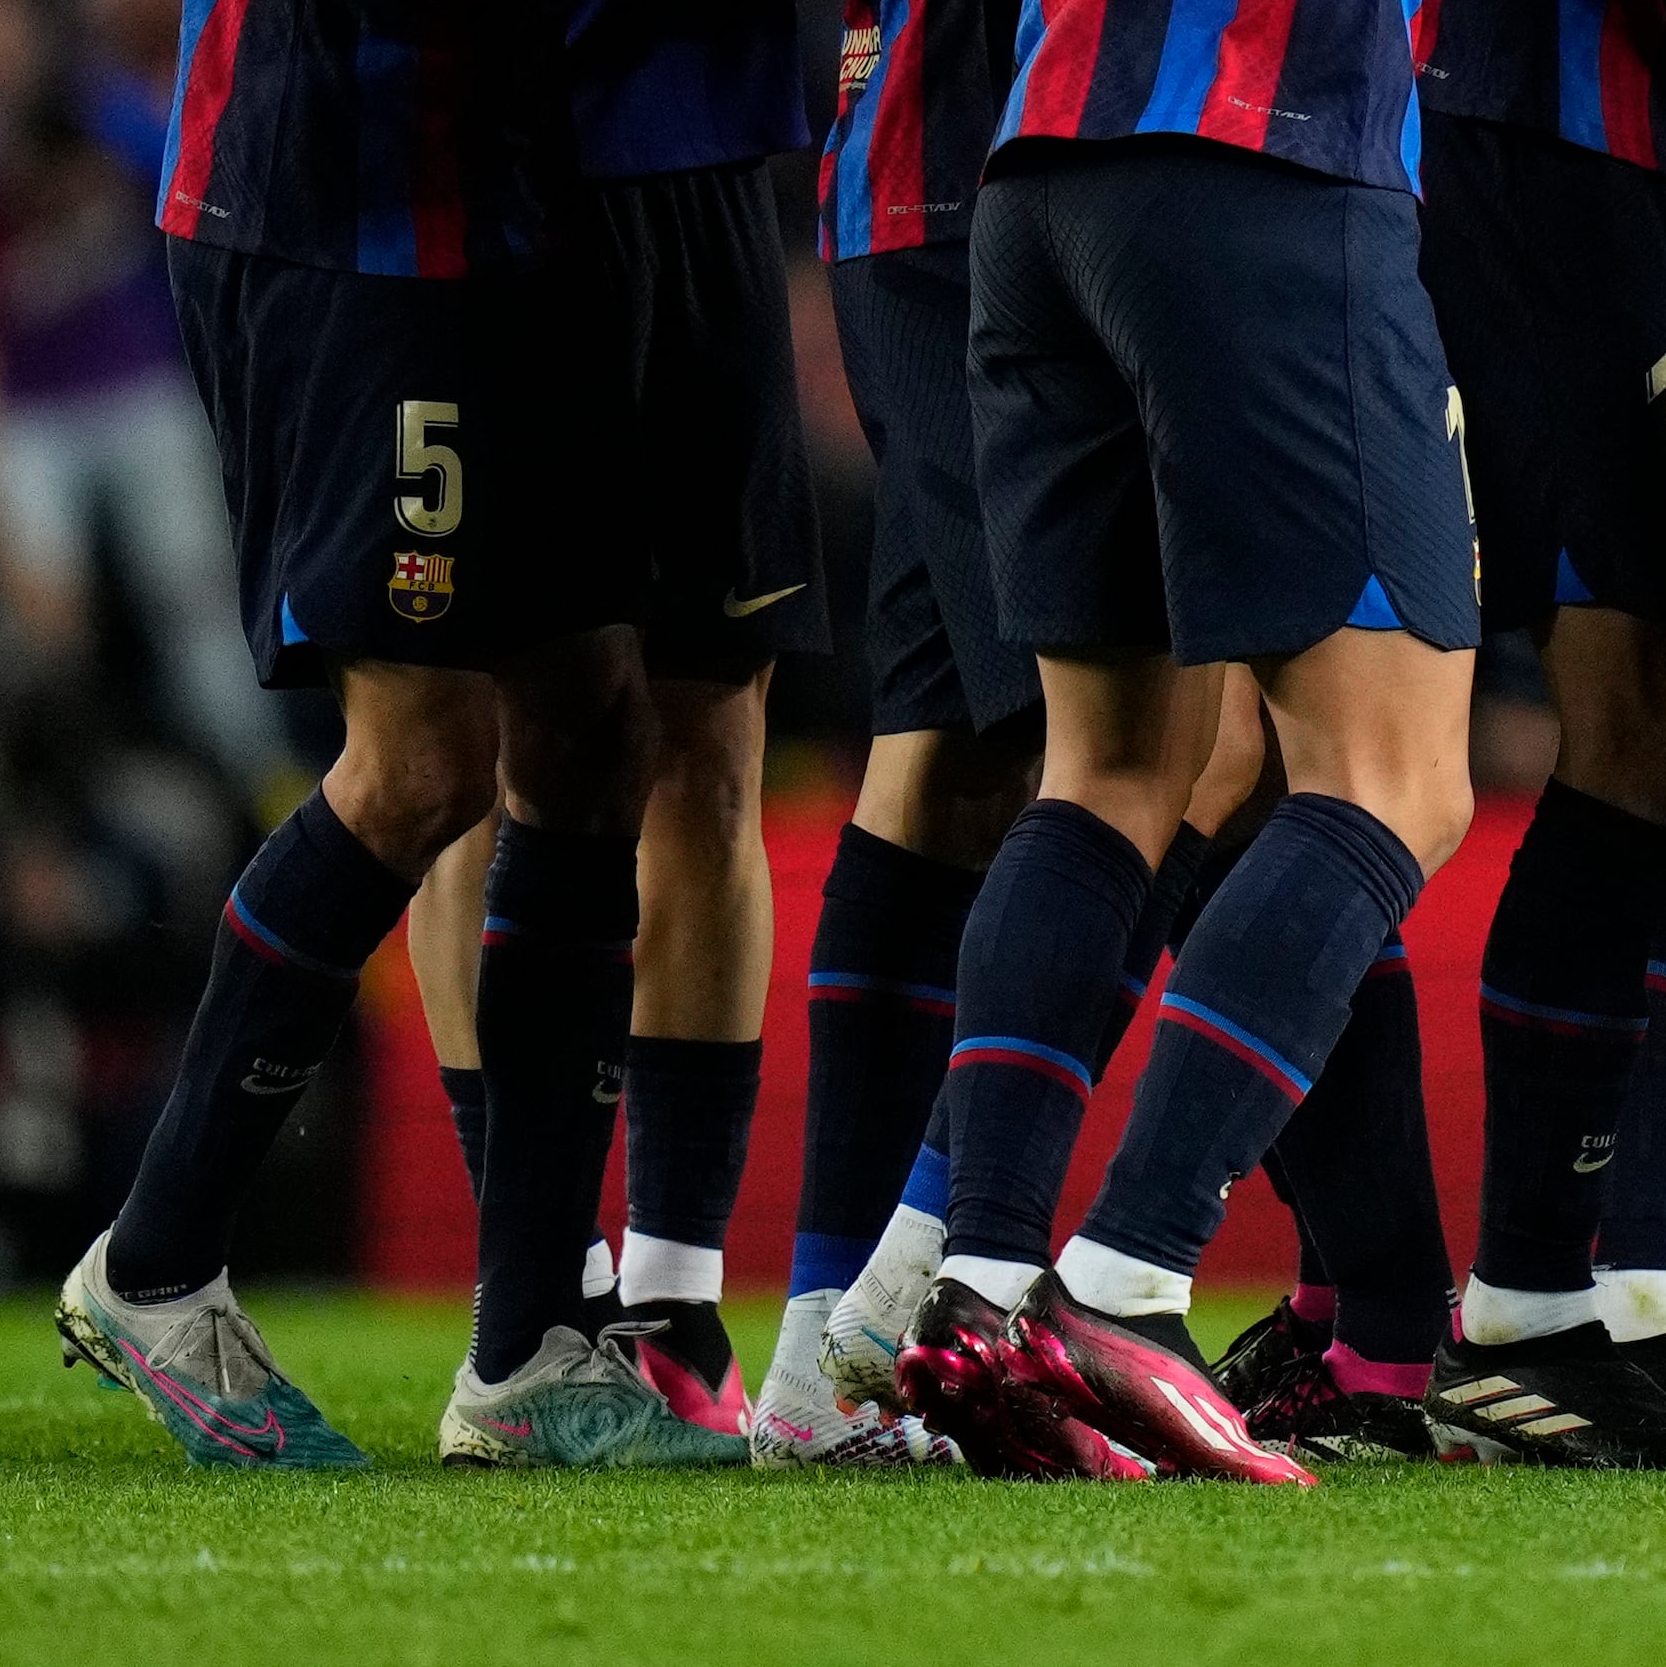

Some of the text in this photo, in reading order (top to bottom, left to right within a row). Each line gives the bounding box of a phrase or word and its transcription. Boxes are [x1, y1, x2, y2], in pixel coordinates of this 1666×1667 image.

[839, 54, 880, 83] CNUR
[393, 399, 464, 538] 5
[409, 581, 435, 591] FCB
